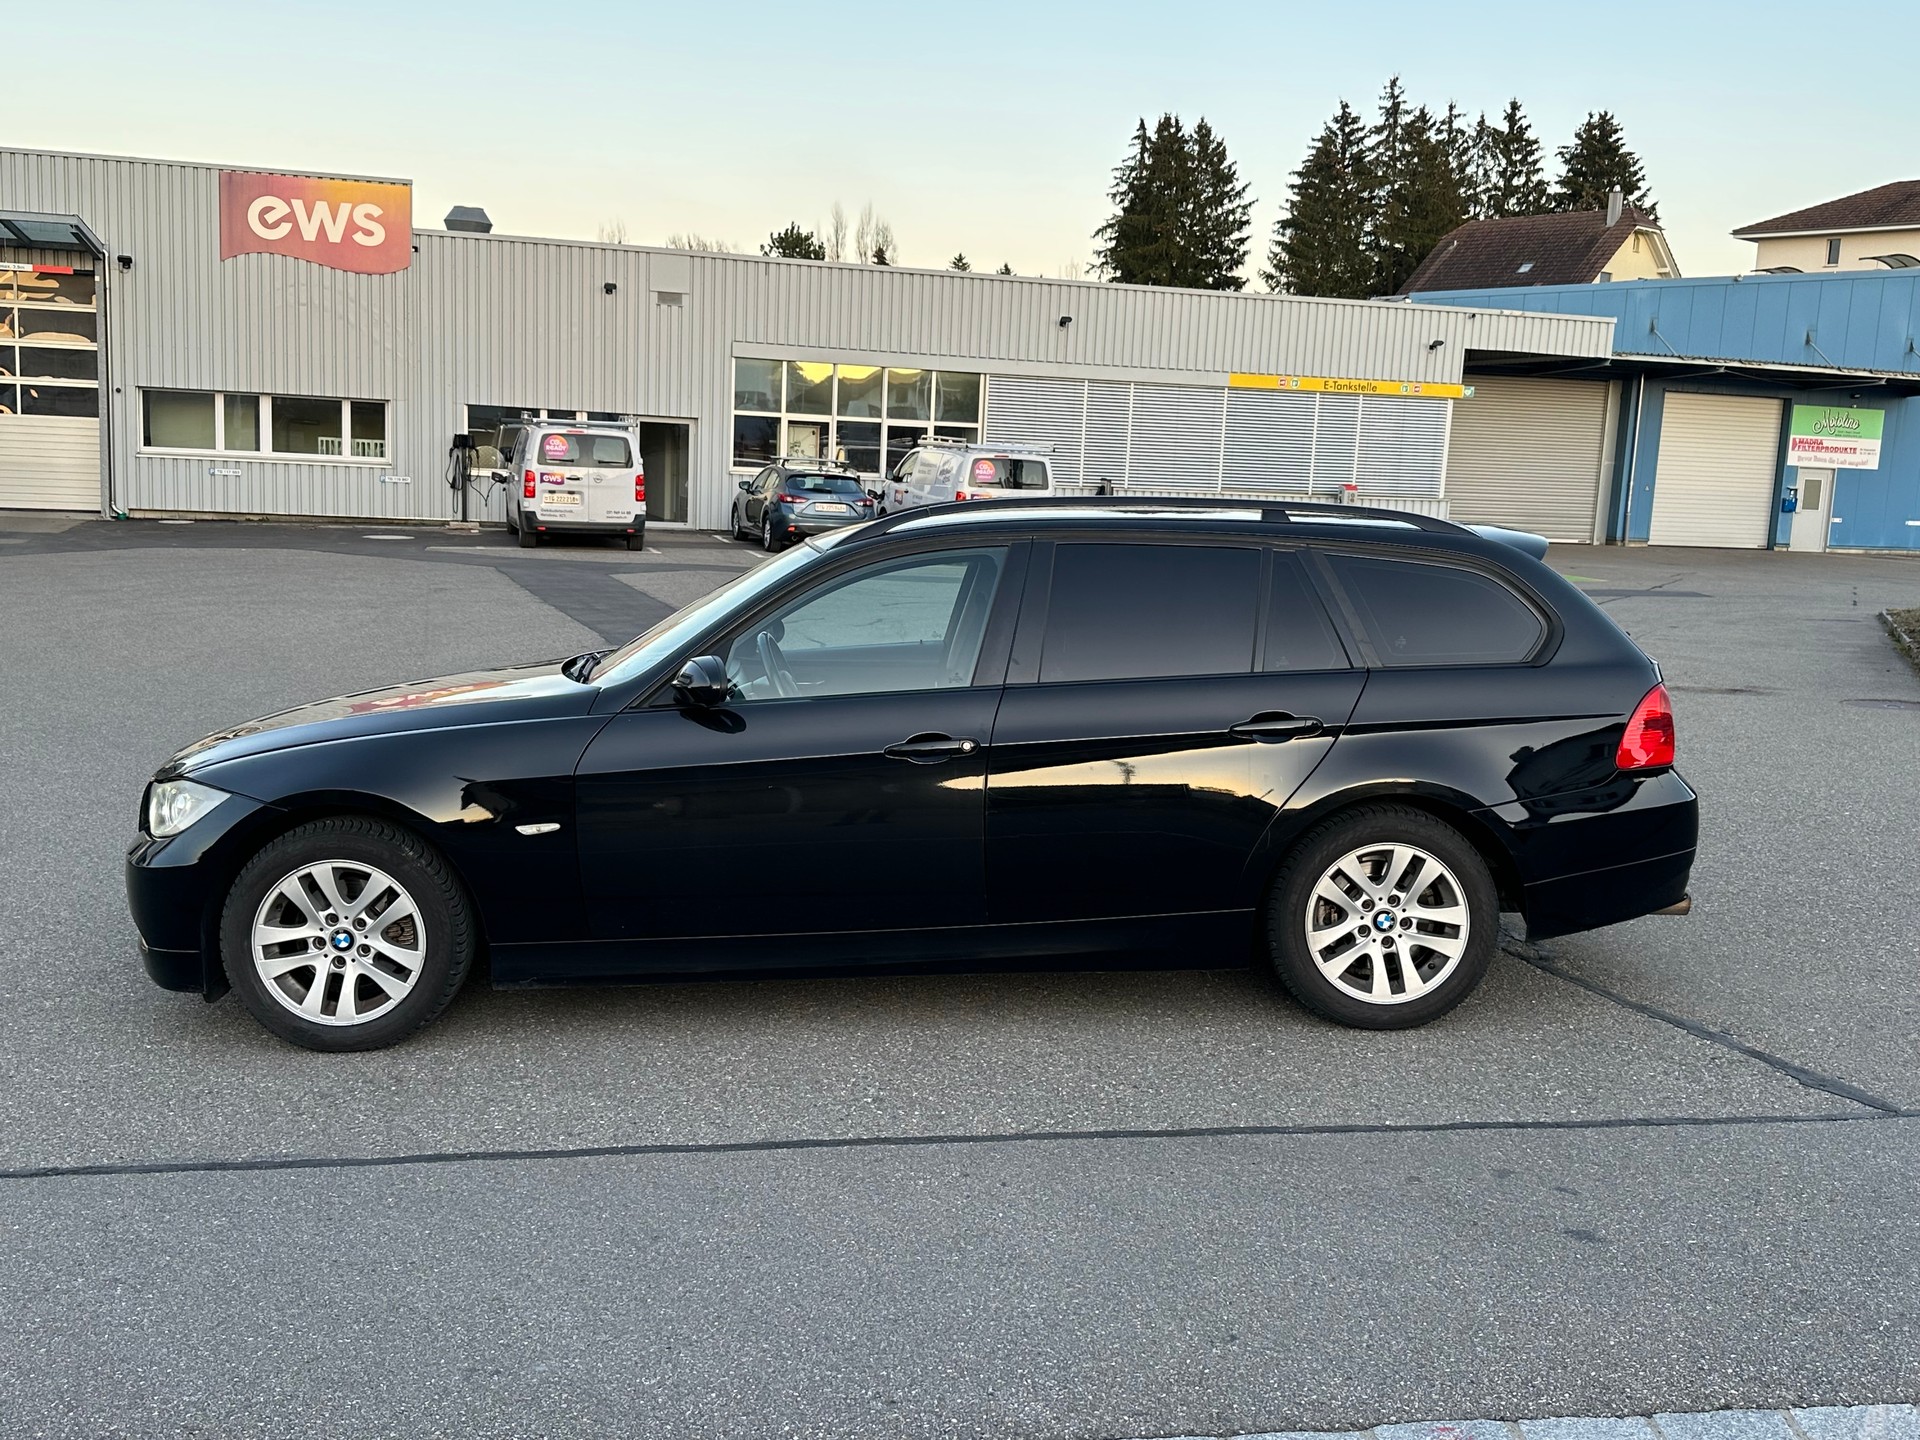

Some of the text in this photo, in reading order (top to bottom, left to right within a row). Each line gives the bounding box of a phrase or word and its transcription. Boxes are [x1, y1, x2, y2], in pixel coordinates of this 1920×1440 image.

[247, 195, 386, 246] ews
[1324, 380, 1377, 392] E-Tankstelle
[1812, 408, 1860, 434] Motolino
[1797, 445, 1857, 454] FILTERPRODUKTE
[543, 474, 562, 482] ews
